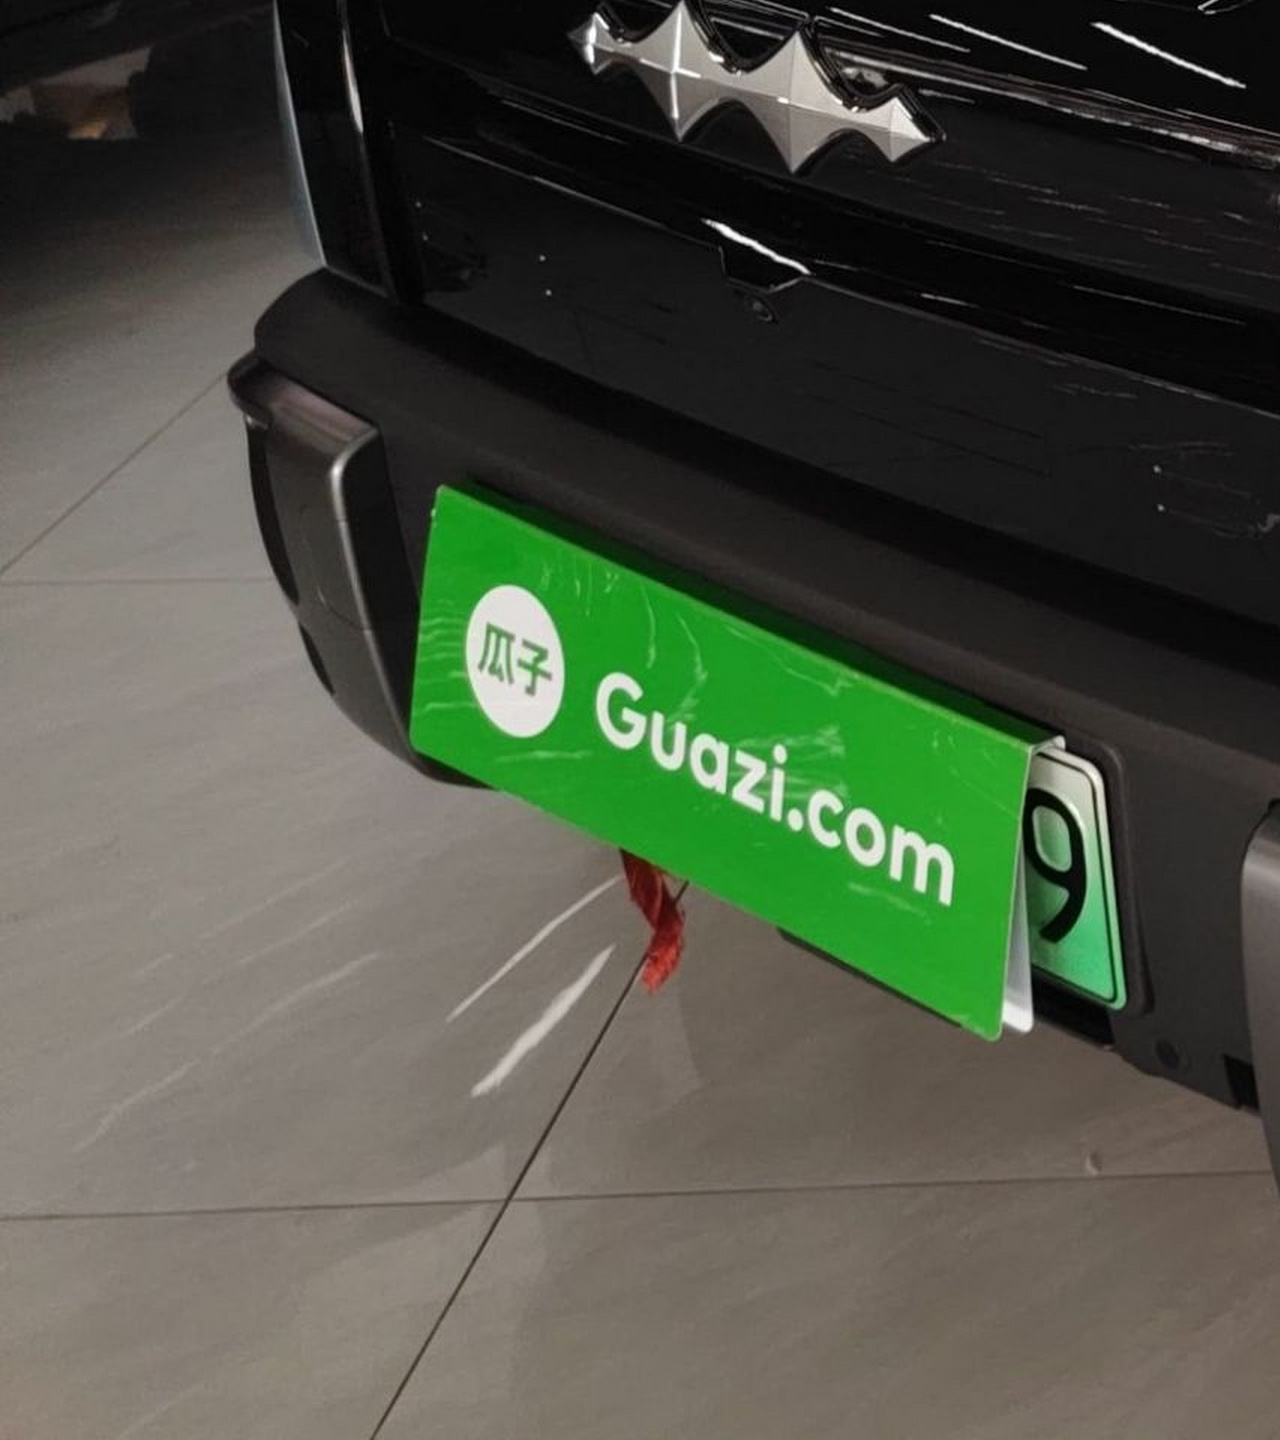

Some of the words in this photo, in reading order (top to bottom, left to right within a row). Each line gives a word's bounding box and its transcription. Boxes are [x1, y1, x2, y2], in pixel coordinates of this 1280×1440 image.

[477, 624, 553, 697] 瓜子
[596, 672, 955, 906] Guazi.com
[1023, 788, 1087, 944] 9
